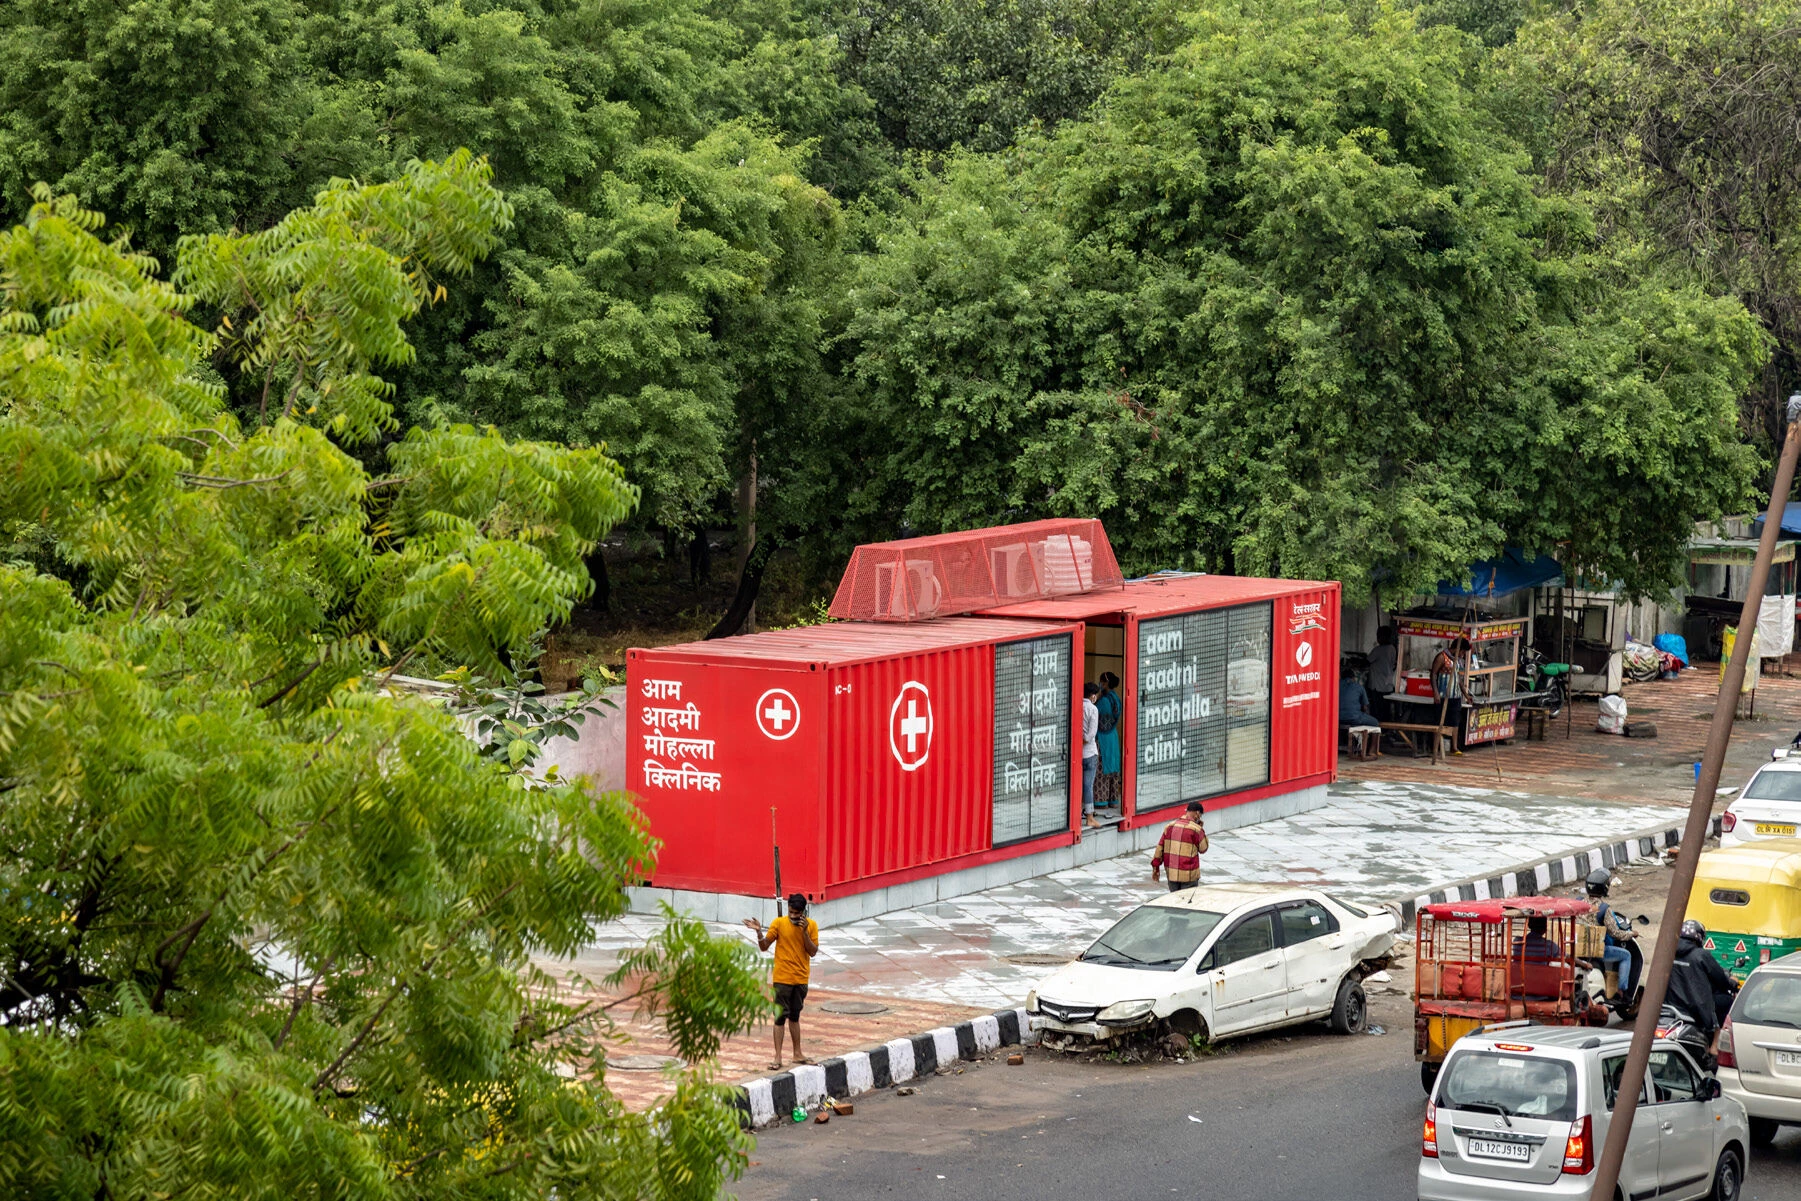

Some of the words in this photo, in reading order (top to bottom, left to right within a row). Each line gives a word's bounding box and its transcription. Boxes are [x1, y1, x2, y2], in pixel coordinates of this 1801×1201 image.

[1146, 631, 1182, 655] aam
[1033, 652, 1058, 676] आम
[1146, 656, 1197, 691] aadmi
[642, 679, 682, 700] आम
[1019, 679, 1057, 715] आदमी
[642, 702, 700, 732] आदमी
[1145, 694, 1210, 728] mohalla
[643, 728, 715, 760] मोहल्ला
[1010, 722, 1057, 754] मोहल्ला
[1144, 732, 1187, 765] clinic
[643, 759, 721, 792] क्लिनिक
[1004, 758, 1057, 795] क्लिनिक
[1474, 1141, 1528, 1157] DL12CJ9193
